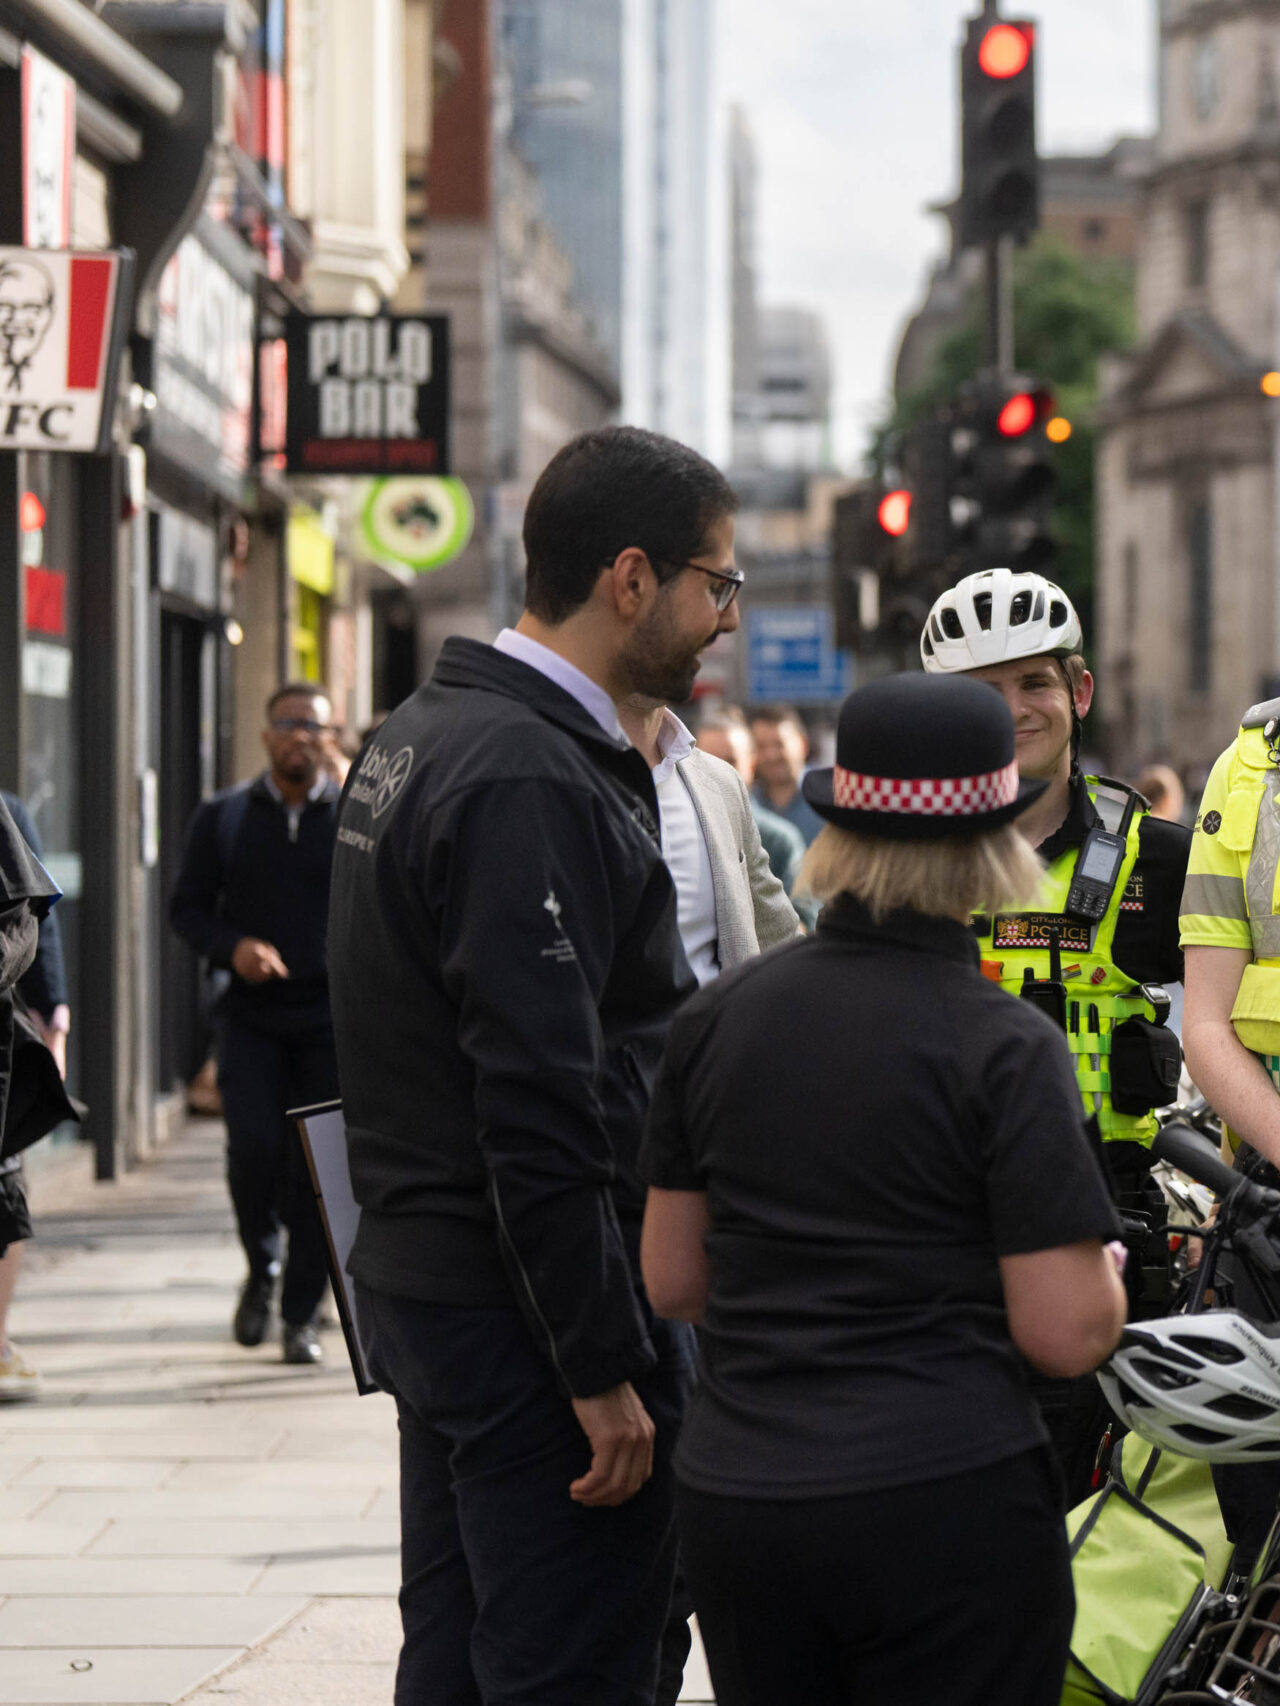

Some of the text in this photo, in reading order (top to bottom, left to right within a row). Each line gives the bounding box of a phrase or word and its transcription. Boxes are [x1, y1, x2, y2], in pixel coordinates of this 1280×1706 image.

[309, 319, 433, 385] POLO
[0, 402, 75, 442] FC
[320, 376, 420, 439] BAR
[1030, 925, 1088, 941] POICE
